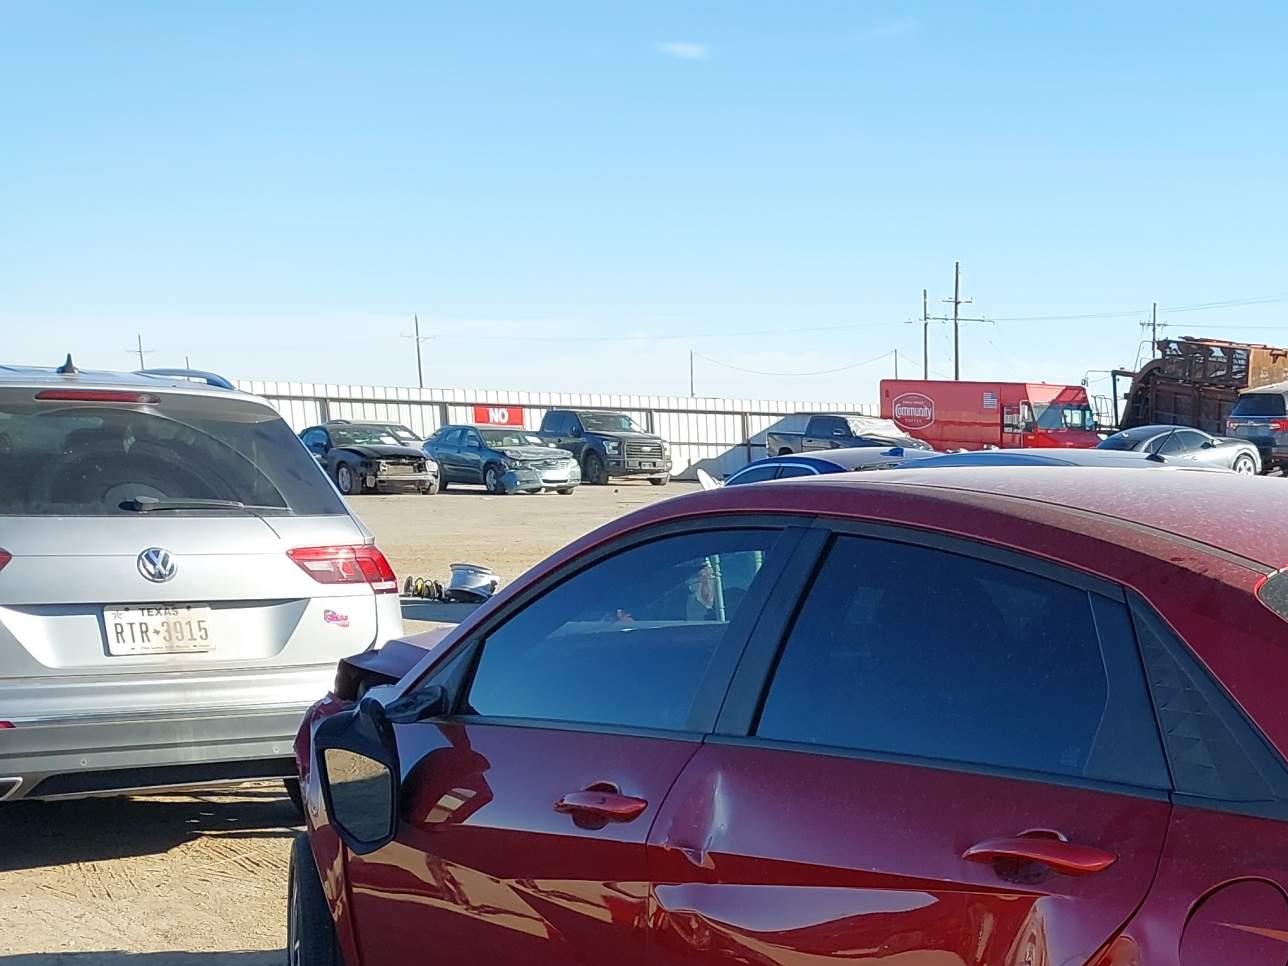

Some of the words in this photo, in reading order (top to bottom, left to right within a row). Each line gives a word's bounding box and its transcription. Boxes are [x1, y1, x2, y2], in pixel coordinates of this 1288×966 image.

[488, 407, 509, 425] NO
[895, 403, 932, 420] Community
[138, 607, 179, 617] TEXAS
